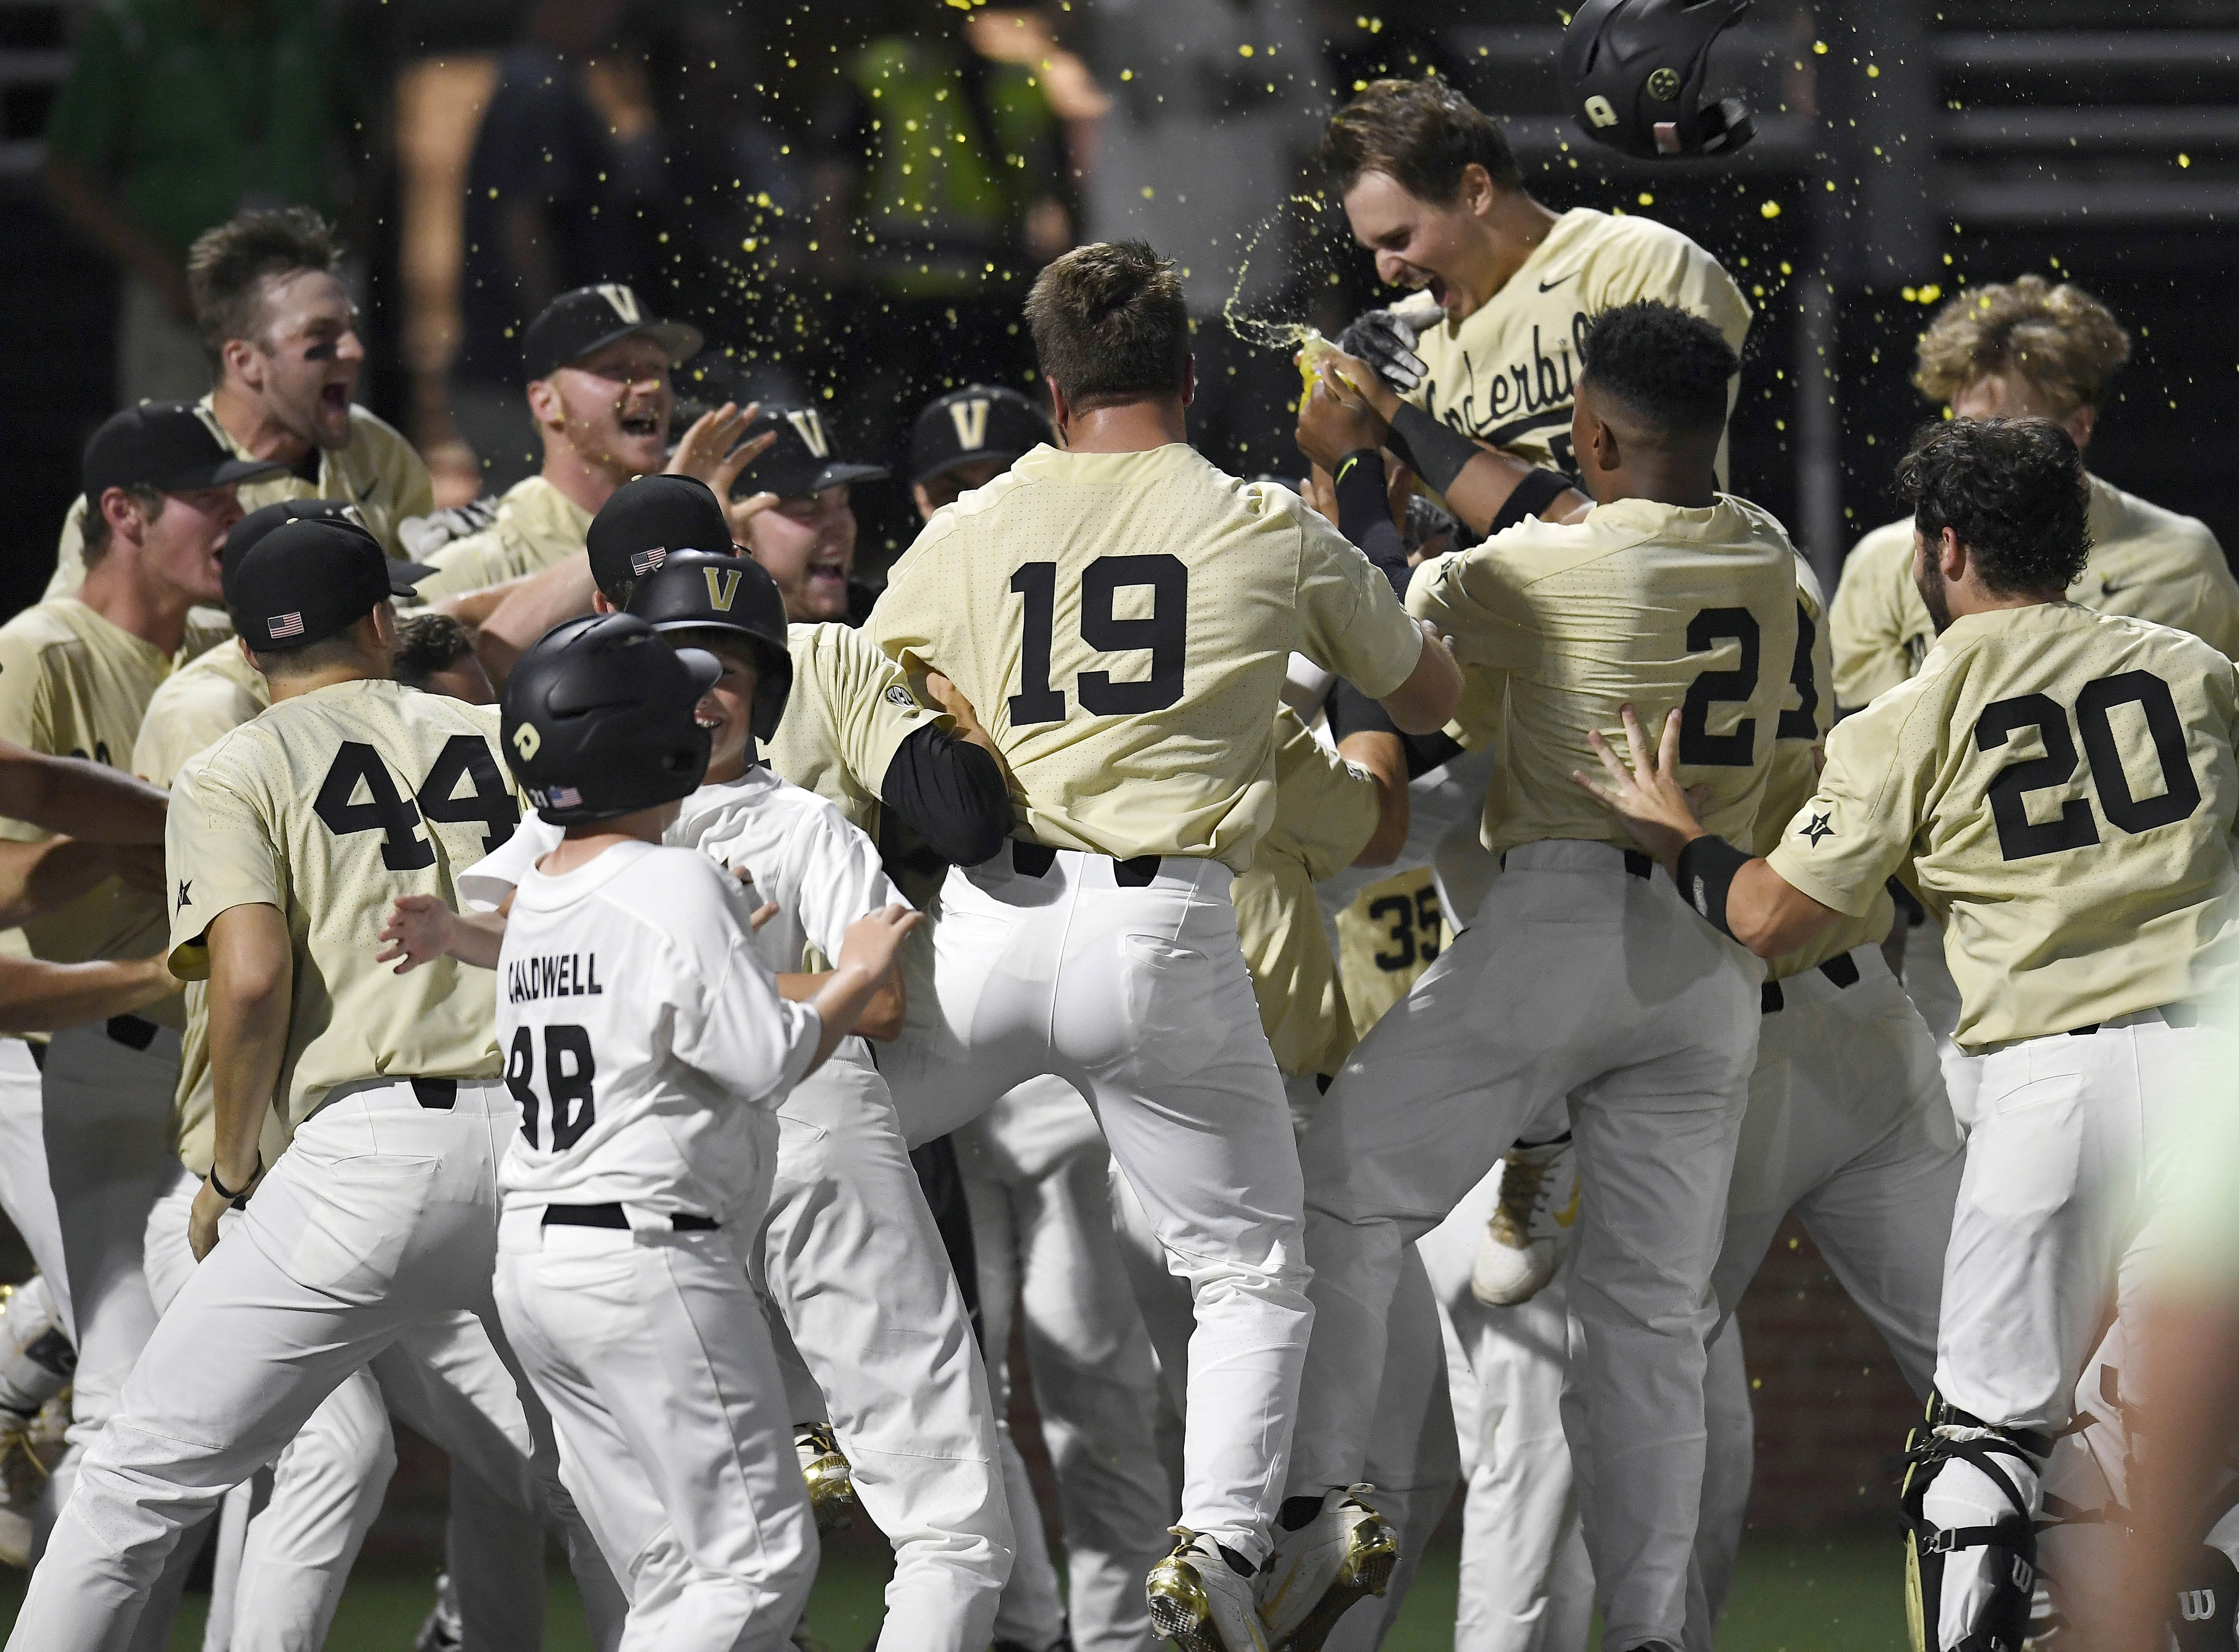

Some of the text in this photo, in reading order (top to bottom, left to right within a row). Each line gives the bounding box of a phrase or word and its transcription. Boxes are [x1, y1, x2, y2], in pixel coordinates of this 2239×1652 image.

[596, 284, 639, 324] V
[786, 409, 829, 458] V
[949, 399, 989, 450] V
[703, 566, 742, 611] V
[1008, 554, 1188, 727] 19
[1679, 607, 1760, 766] 2
[1974, 669, 2202, 862] 20
[312, 735, 521, 871] 44
[1368, 884, 1441, 972] 35
[508, 952, 602, 1004] CALDWELL
[812, 1437, 831, 1450] V
